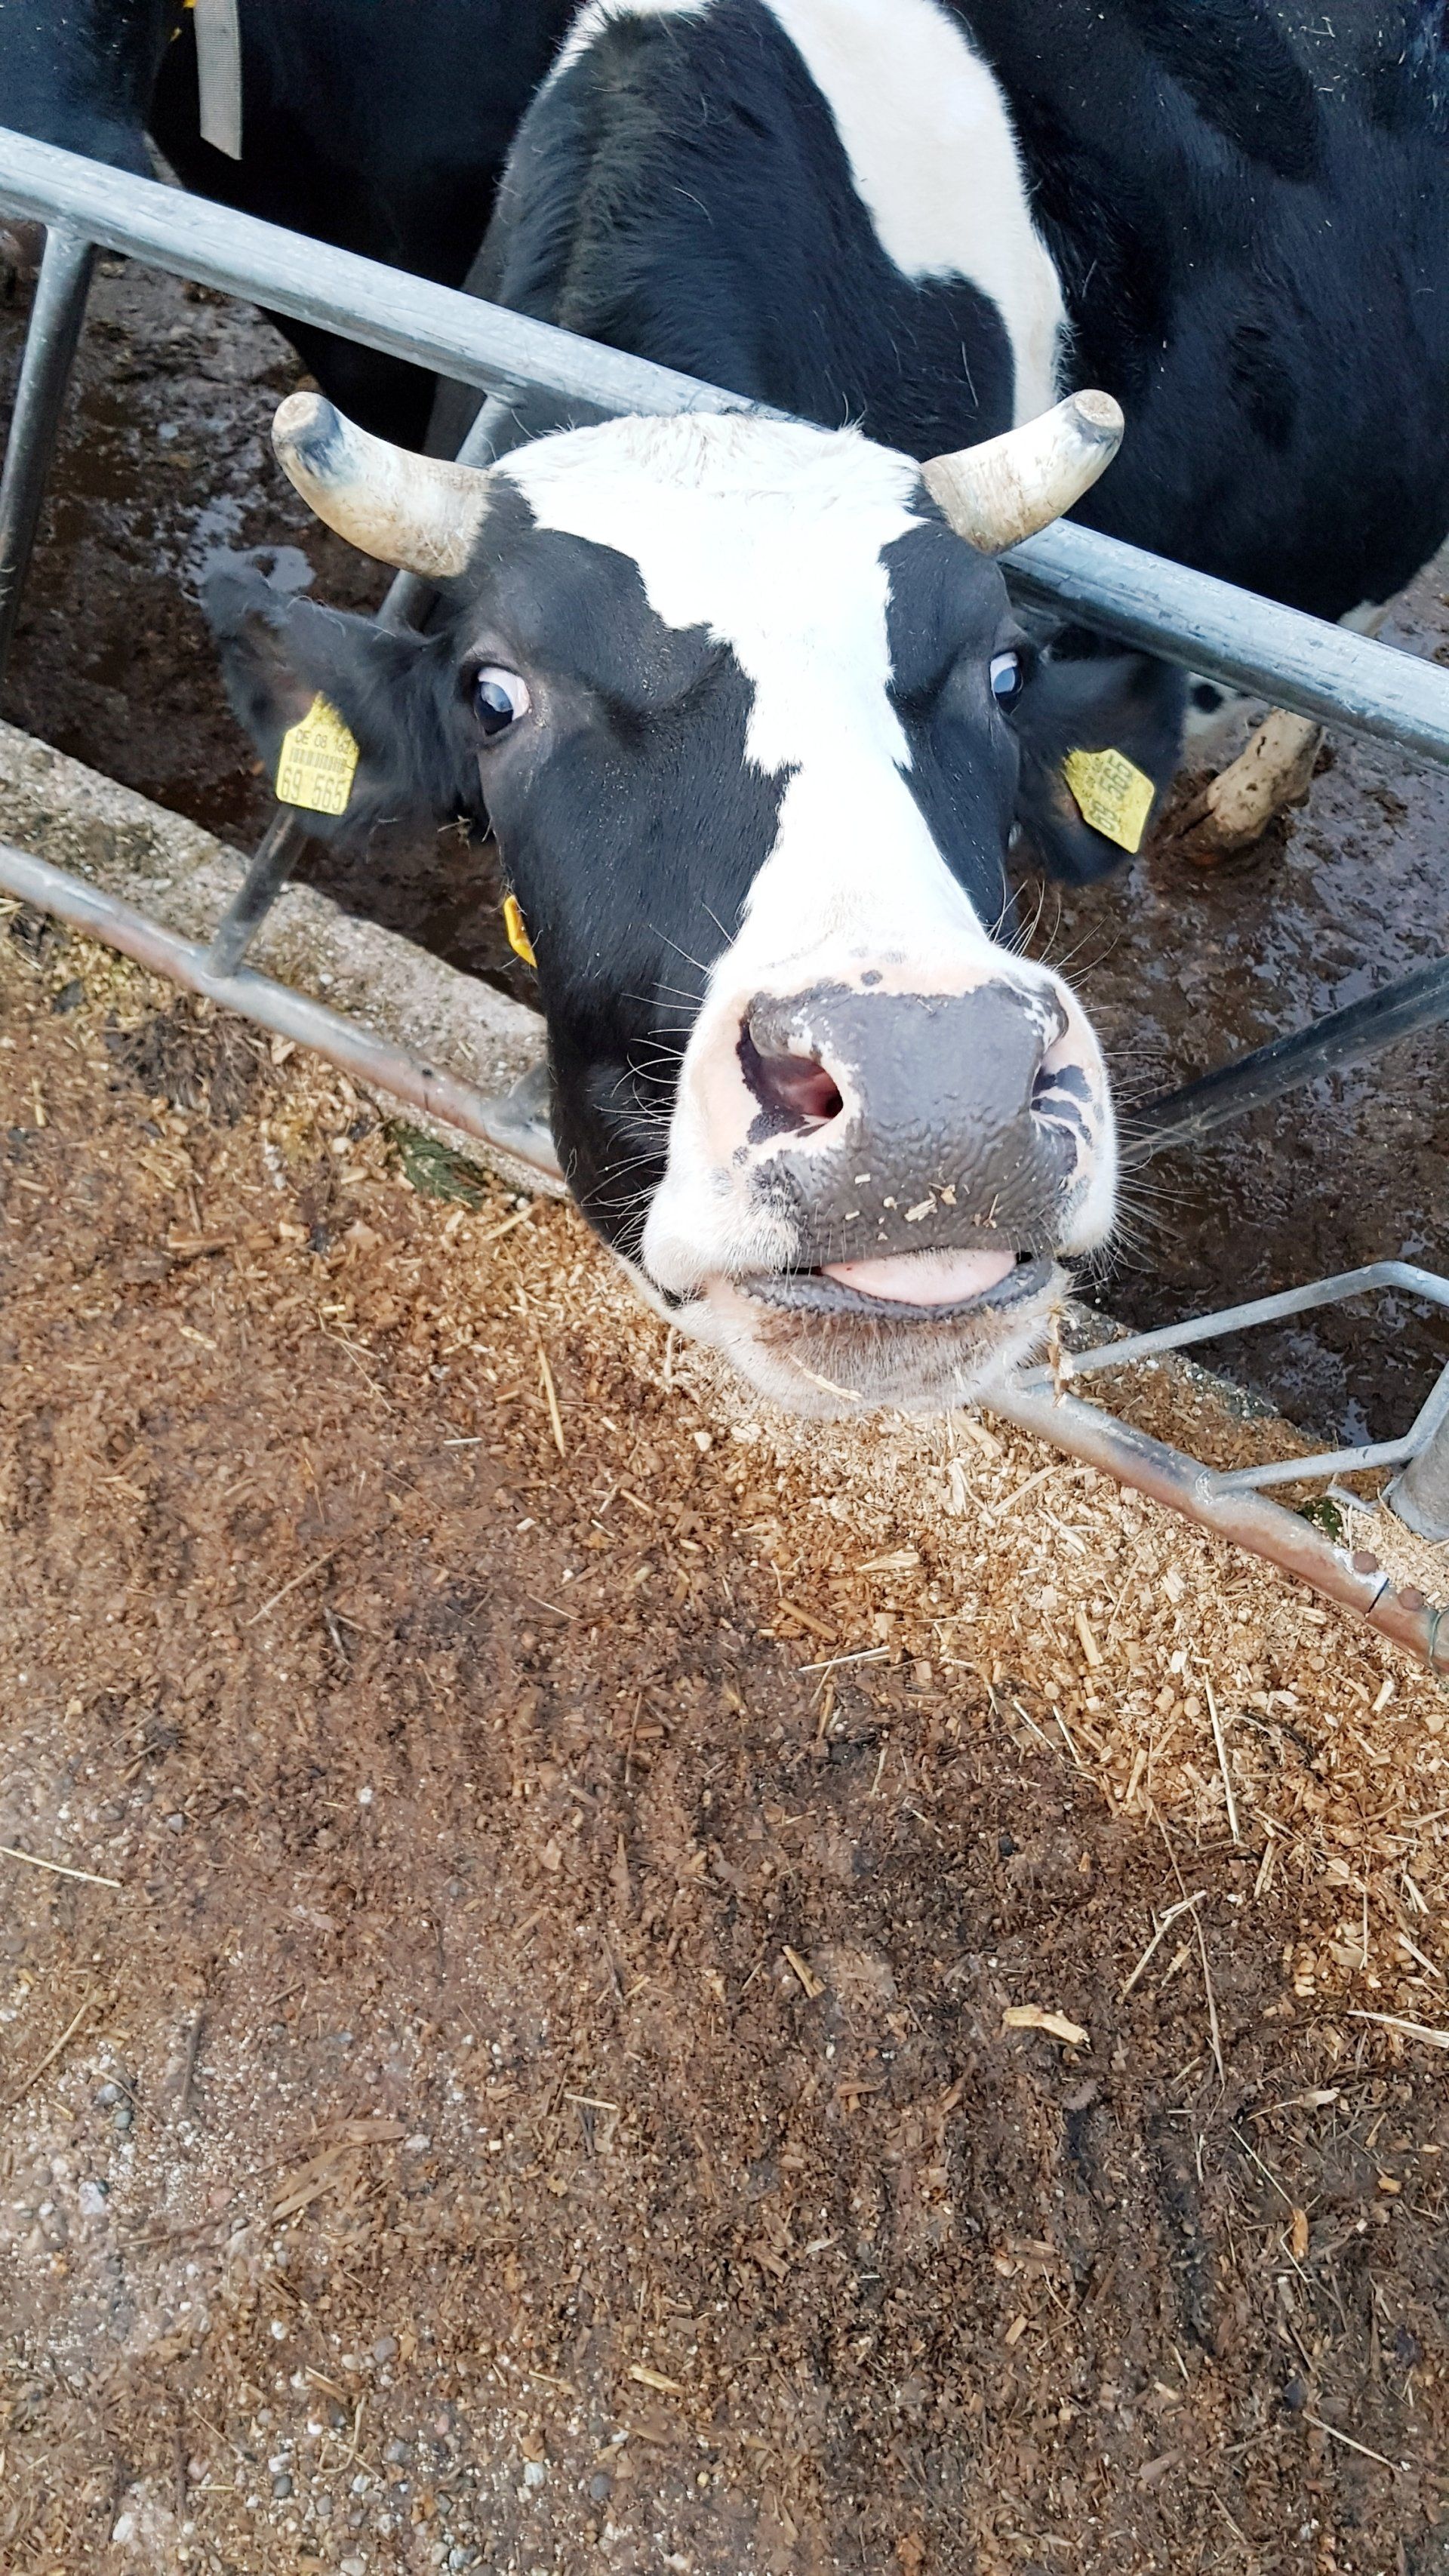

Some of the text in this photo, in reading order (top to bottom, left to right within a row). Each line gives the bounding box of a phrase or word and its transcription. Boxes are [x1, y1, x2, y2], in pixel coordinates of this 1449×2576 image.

[295, 729, 310, 745] DE
[314, 734, 328, 749] 08
[281, 765, 346, 811] 69 565
[1100, 755, 1132, 801] 565
[1088, 800, 1116, 832] 69
